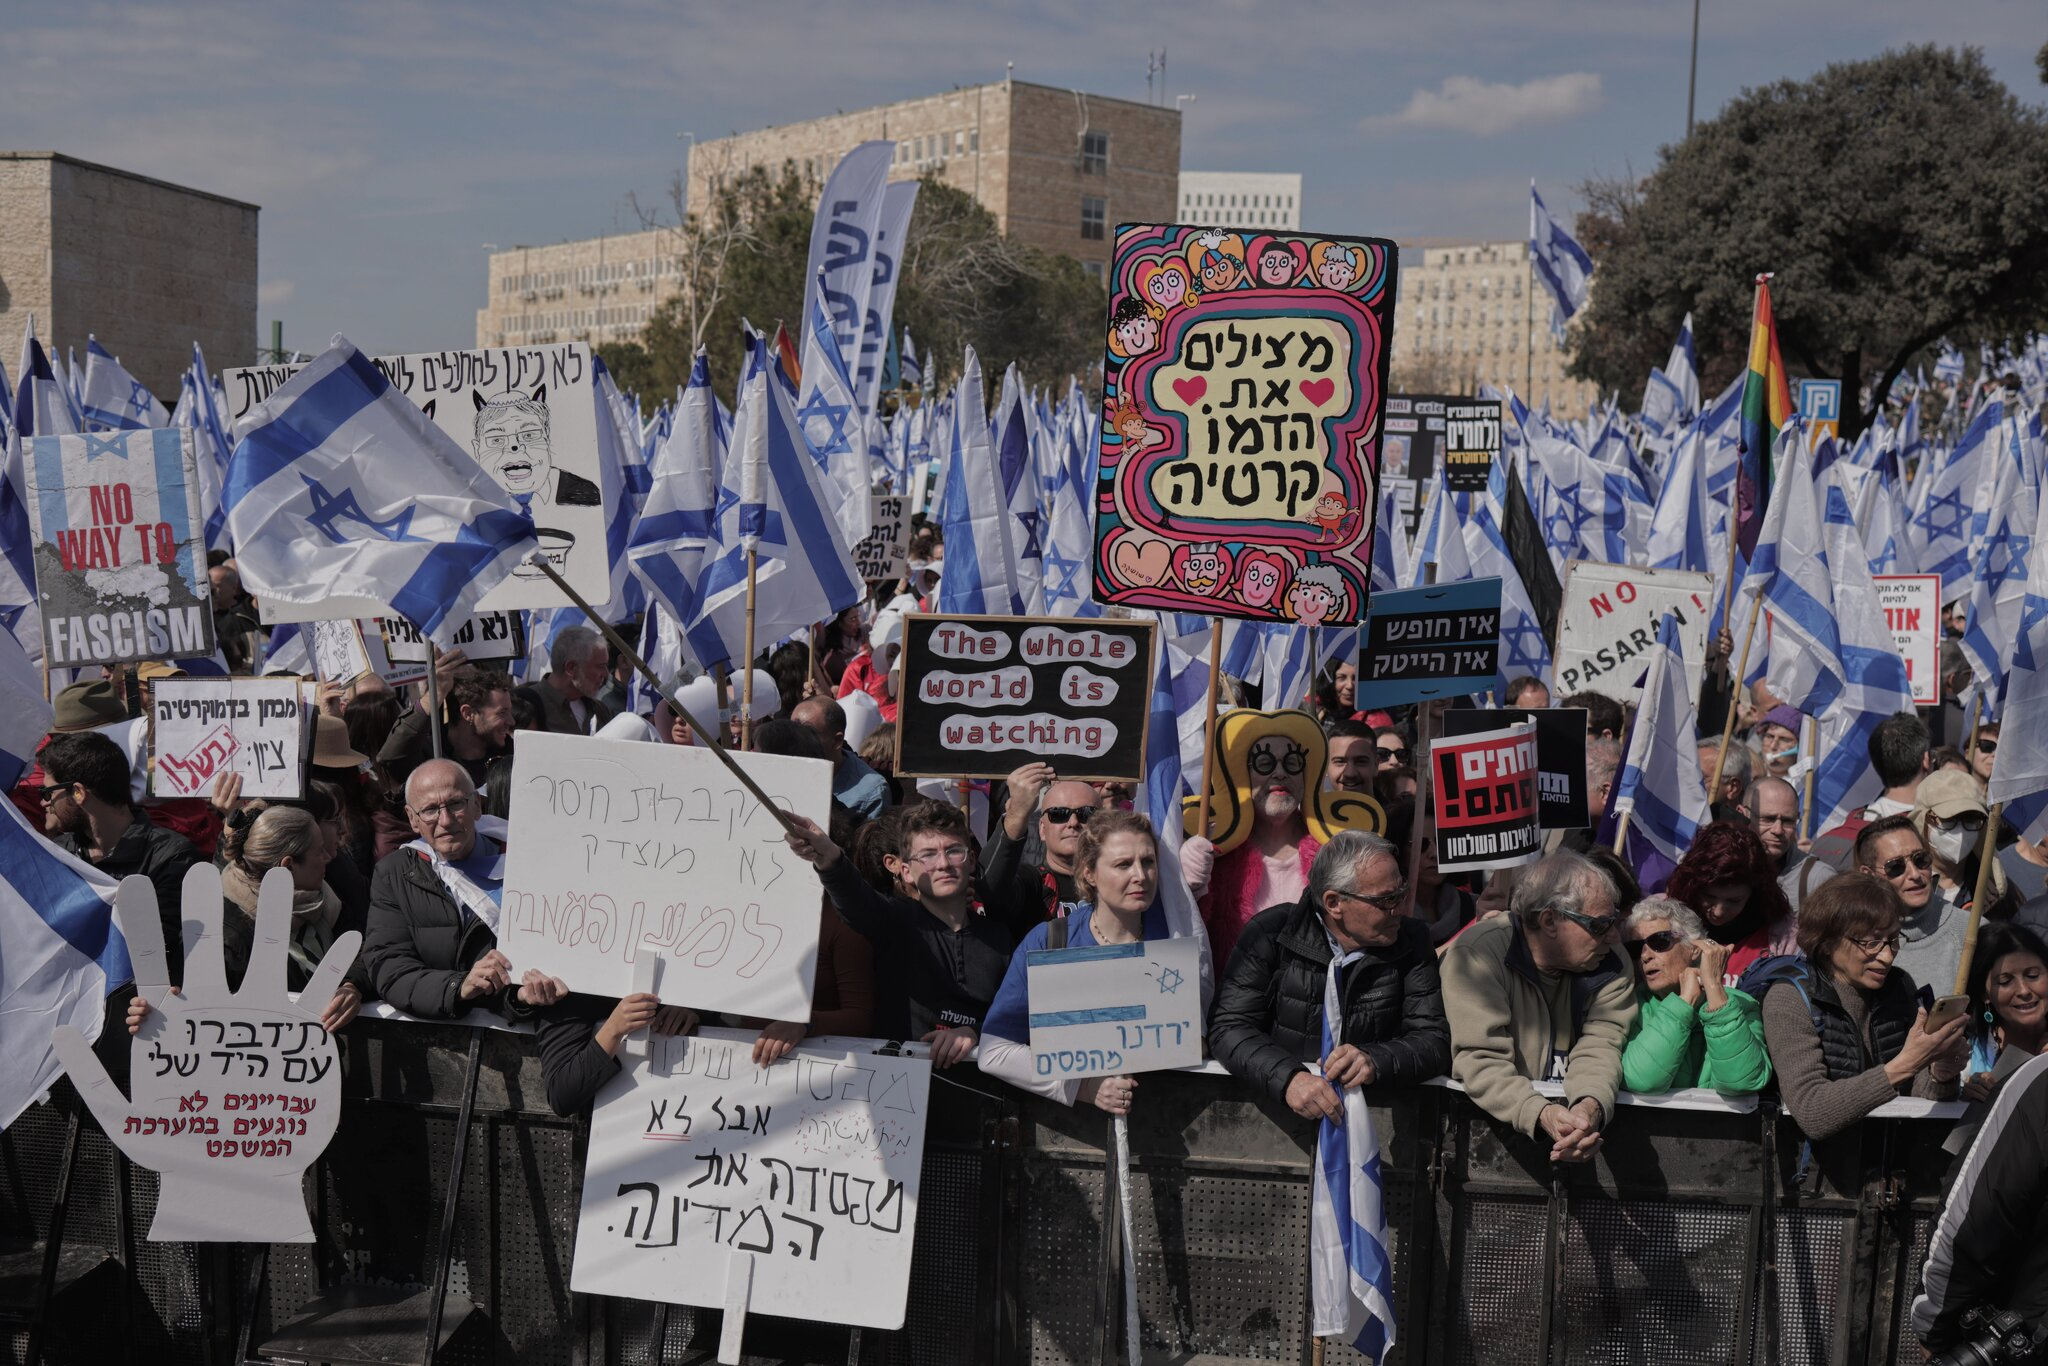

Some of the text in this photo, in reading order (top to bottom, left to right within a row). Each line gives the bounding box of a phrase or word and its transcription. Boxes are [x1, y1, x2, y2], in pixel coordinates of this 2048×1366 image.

[1185, 322, 1334, 372] מצילים
[552, 344, 582, 390] לא
[1220, 377, 1292, 409] את
[1169, 459, 1321, 517] קרטיה
[89, 482, 134, 527] NO
[56, 521, 177, 572] WAY TO
[1589, 581, 1637, 619] NO
[1893, 584, 1906, 592] לא
[1908, 585, 1921, 593] אם
[49, 605, 206, 663] FASCISM
[480, 610, 508, 641] לא
[1385, 614, 1495, 642] אין חופש
[939, 630, 1126, 659] The whole
[1373, 650, 1489, 679] אין הייטק
[927, 674, 1105, 700] world is
[157, 698, 297, 727] מבחן בדמוקרטיה
[946, 718, 1102, 750] watching
[247, 740, 287, 783] ציון:
[1447, 833, 1498, 860] השלטון
[1500, 824, 1533, 852] לאיכות
[582, 834, 784, 892] לא מוצדק
[507, 890, 783, 979] למען המאבק
[148, 1041, 332, 1084] עם היד שלי
[1036, 1049, 1123, 1075] מהפסים
[178, 1089, 317, 1114] עבריינים לא
[646, 1095, 772, 1136] אבל לא
[123, 1116, 307, 1137] נוגעים במערכת
[206, 1139, 292, 1158] המשפט
[687, 1147, 904, 1234] מפסידה את
[607, 1182, 825, 1261] המדינה.
